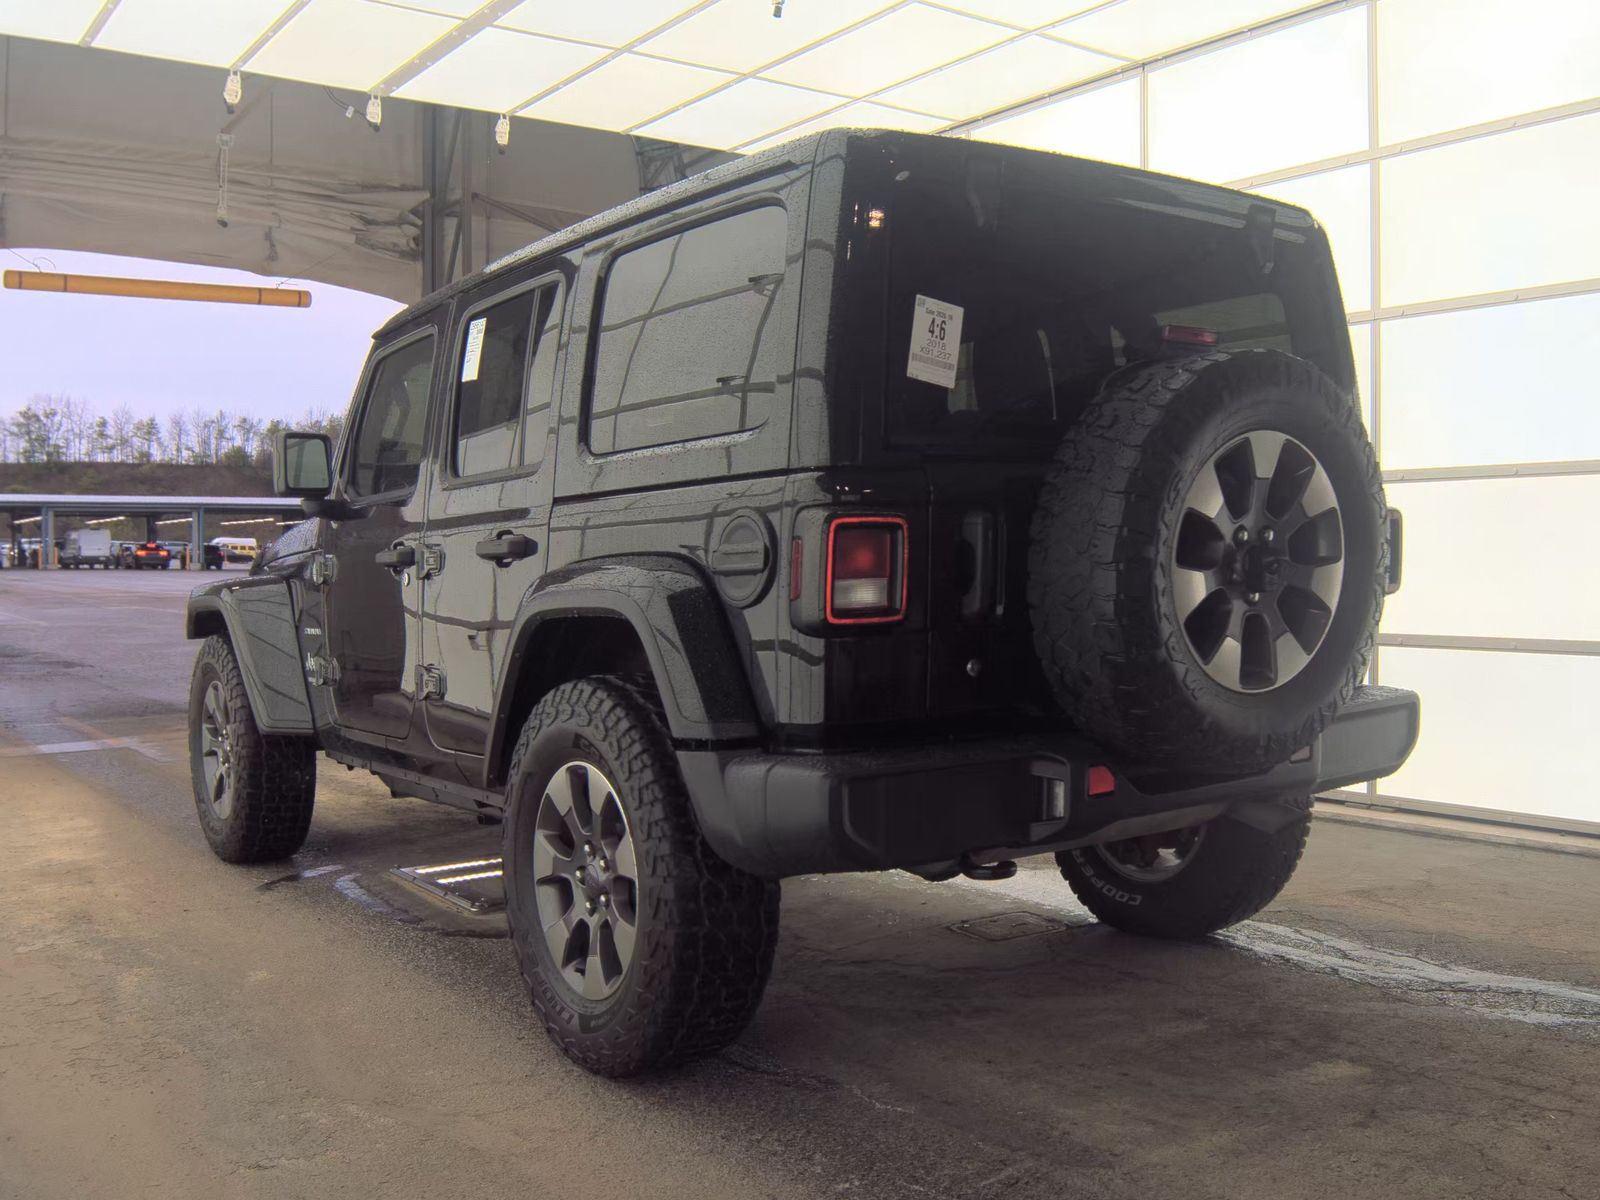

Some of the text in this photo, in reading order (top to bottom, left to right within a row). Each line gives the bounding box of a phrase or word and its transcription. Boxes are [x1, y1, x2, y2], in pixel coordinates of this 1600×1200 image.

[928, 318, 947, 341] 4:6
[926, 338, 947, 352] 2018
[1071, 848, 1143, 905] COOPER
